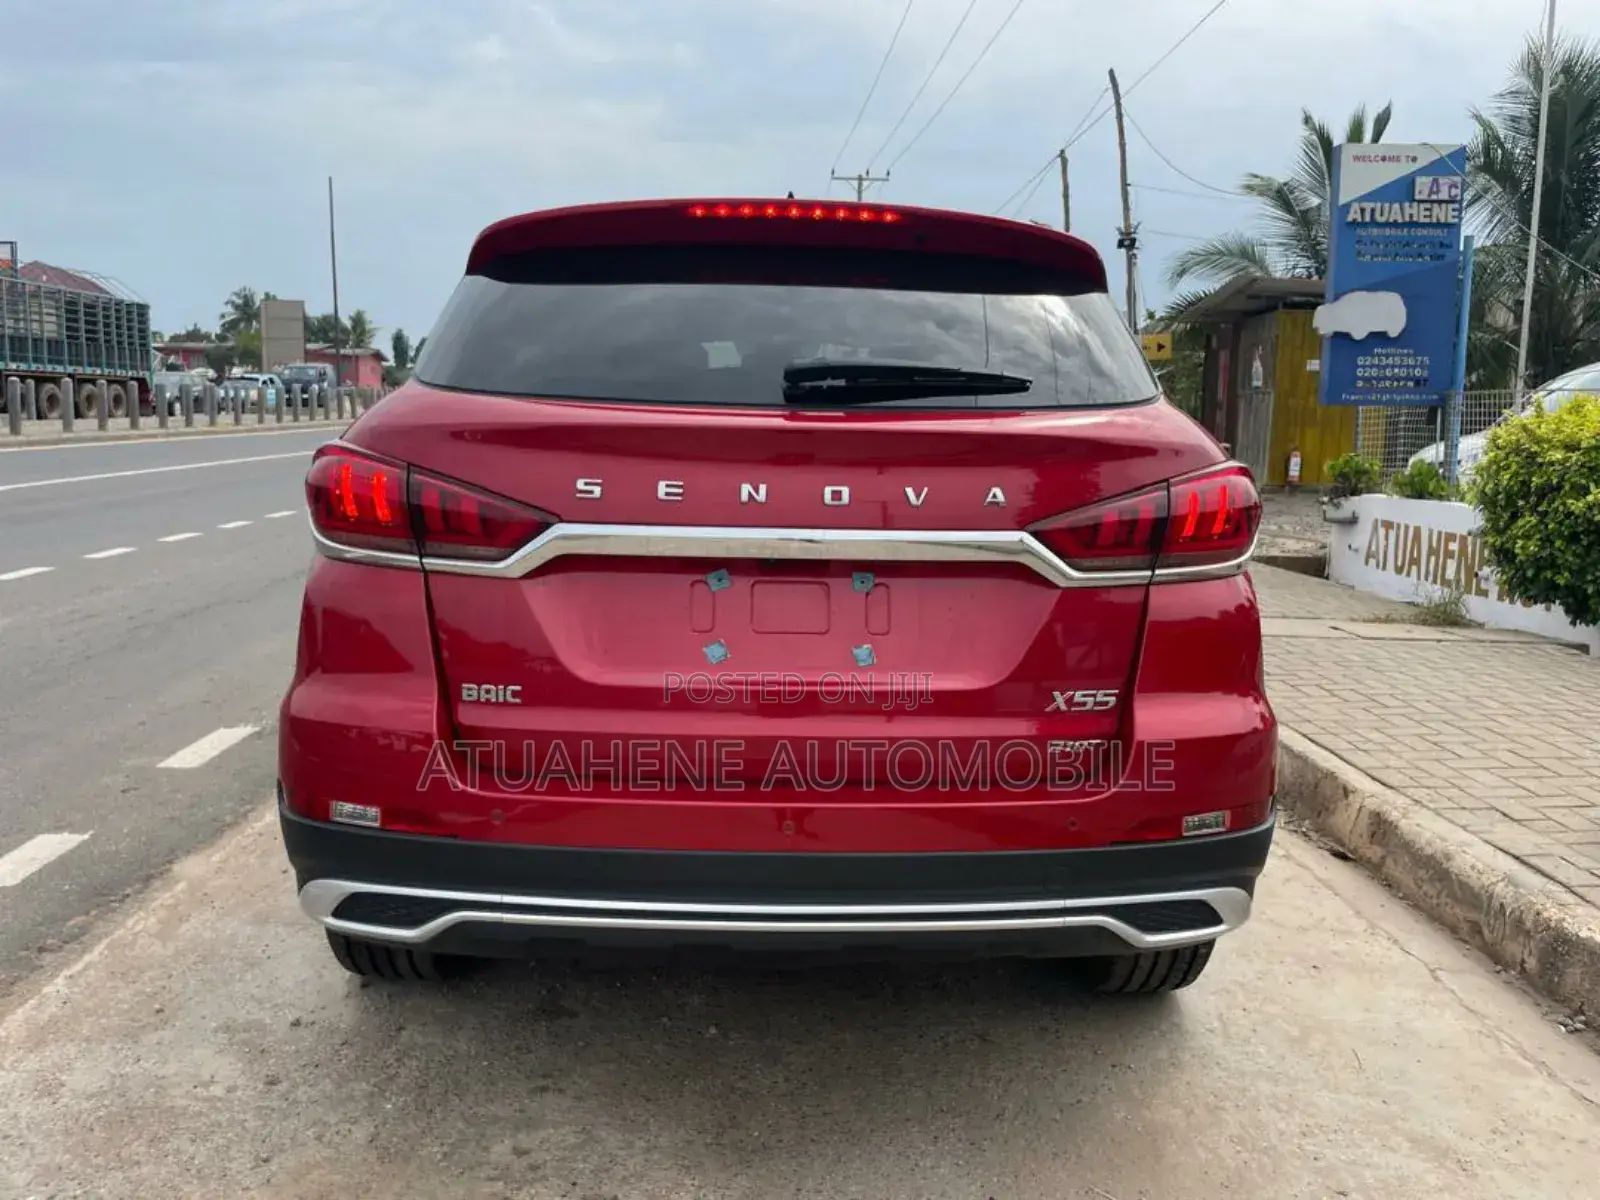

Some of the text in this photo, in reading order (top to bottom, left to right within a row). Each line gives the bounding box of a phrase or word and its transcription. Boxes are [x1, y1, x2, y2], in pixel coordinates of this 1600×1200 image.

[1353, 154, 1418, 163] WELCOME TO
[1347, 202, 1460, 223] ATUAHENE
[575, 478, 1007, 507] SENOVA
[1364, 518, 1490, 599] ATUAHENE
[461, 684, 522, 705] BAIC
[1045, 689, 1120, 712] X55
